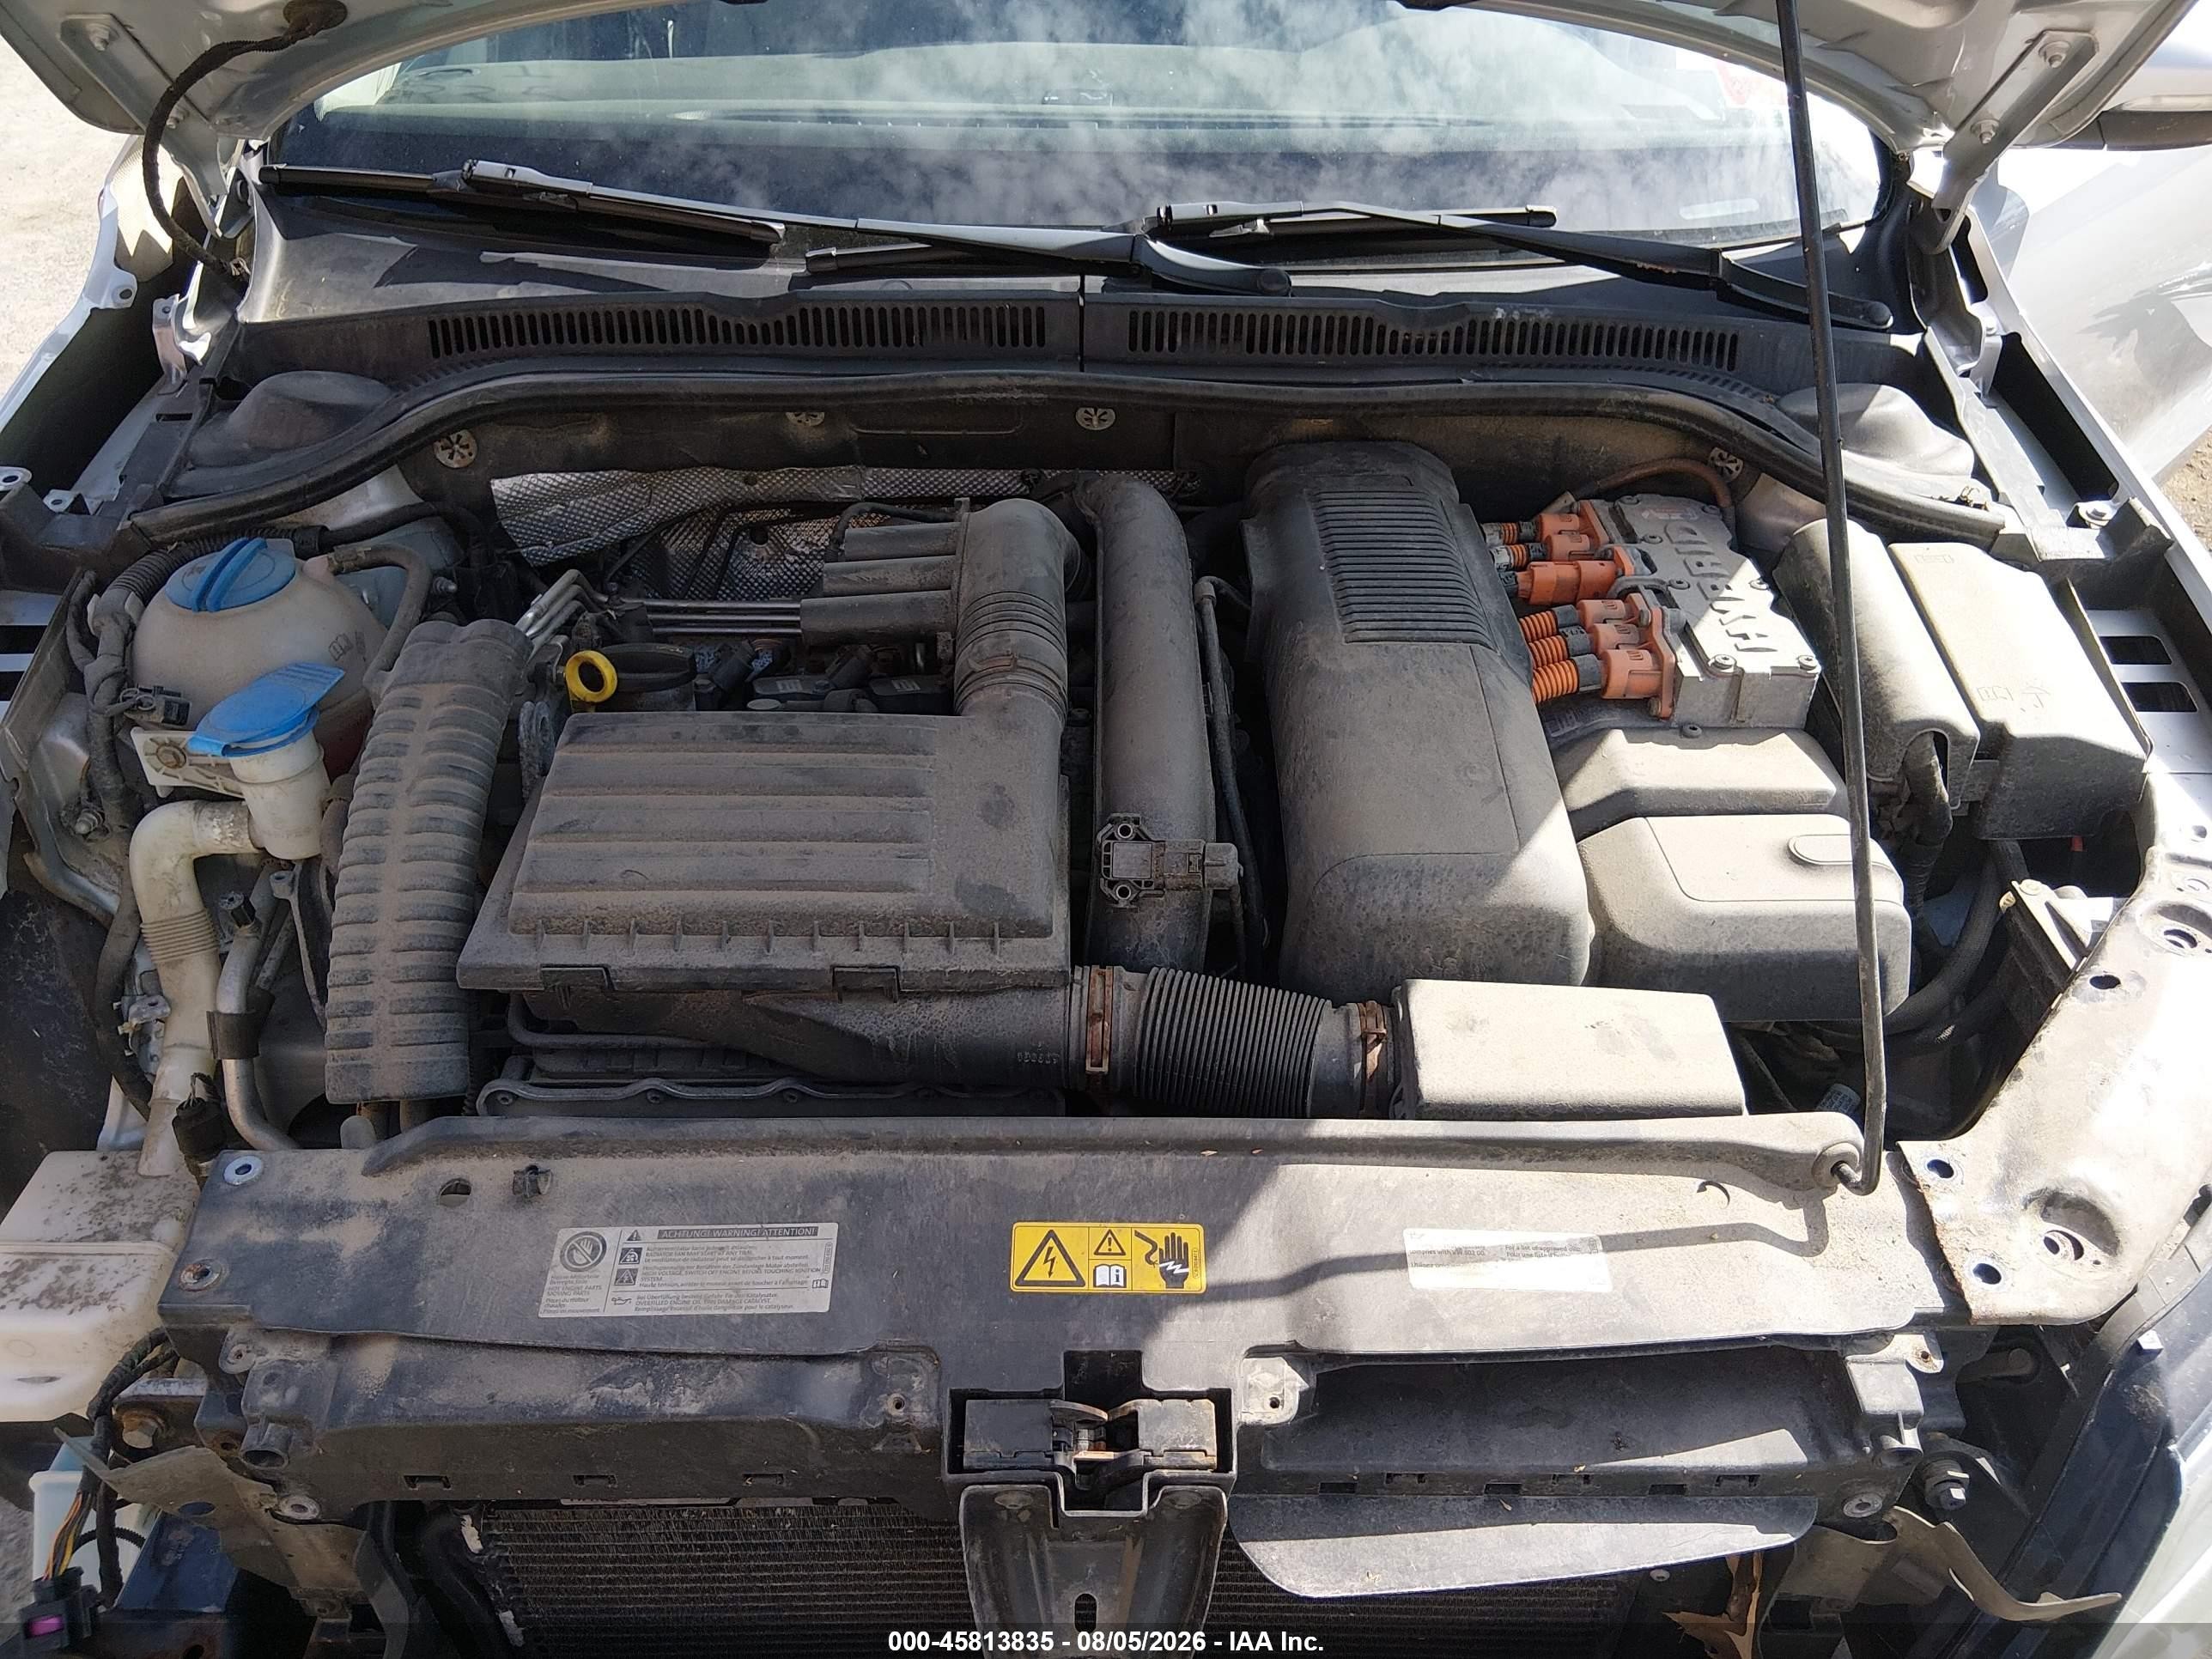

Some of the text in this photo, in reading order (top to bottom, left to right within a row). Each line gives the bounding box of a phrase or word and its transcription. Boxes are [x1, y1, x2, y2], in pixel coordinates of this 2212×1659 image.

[661, 1227, 814, 1237] ACHTUNG! WARNING! ATTENTION!
